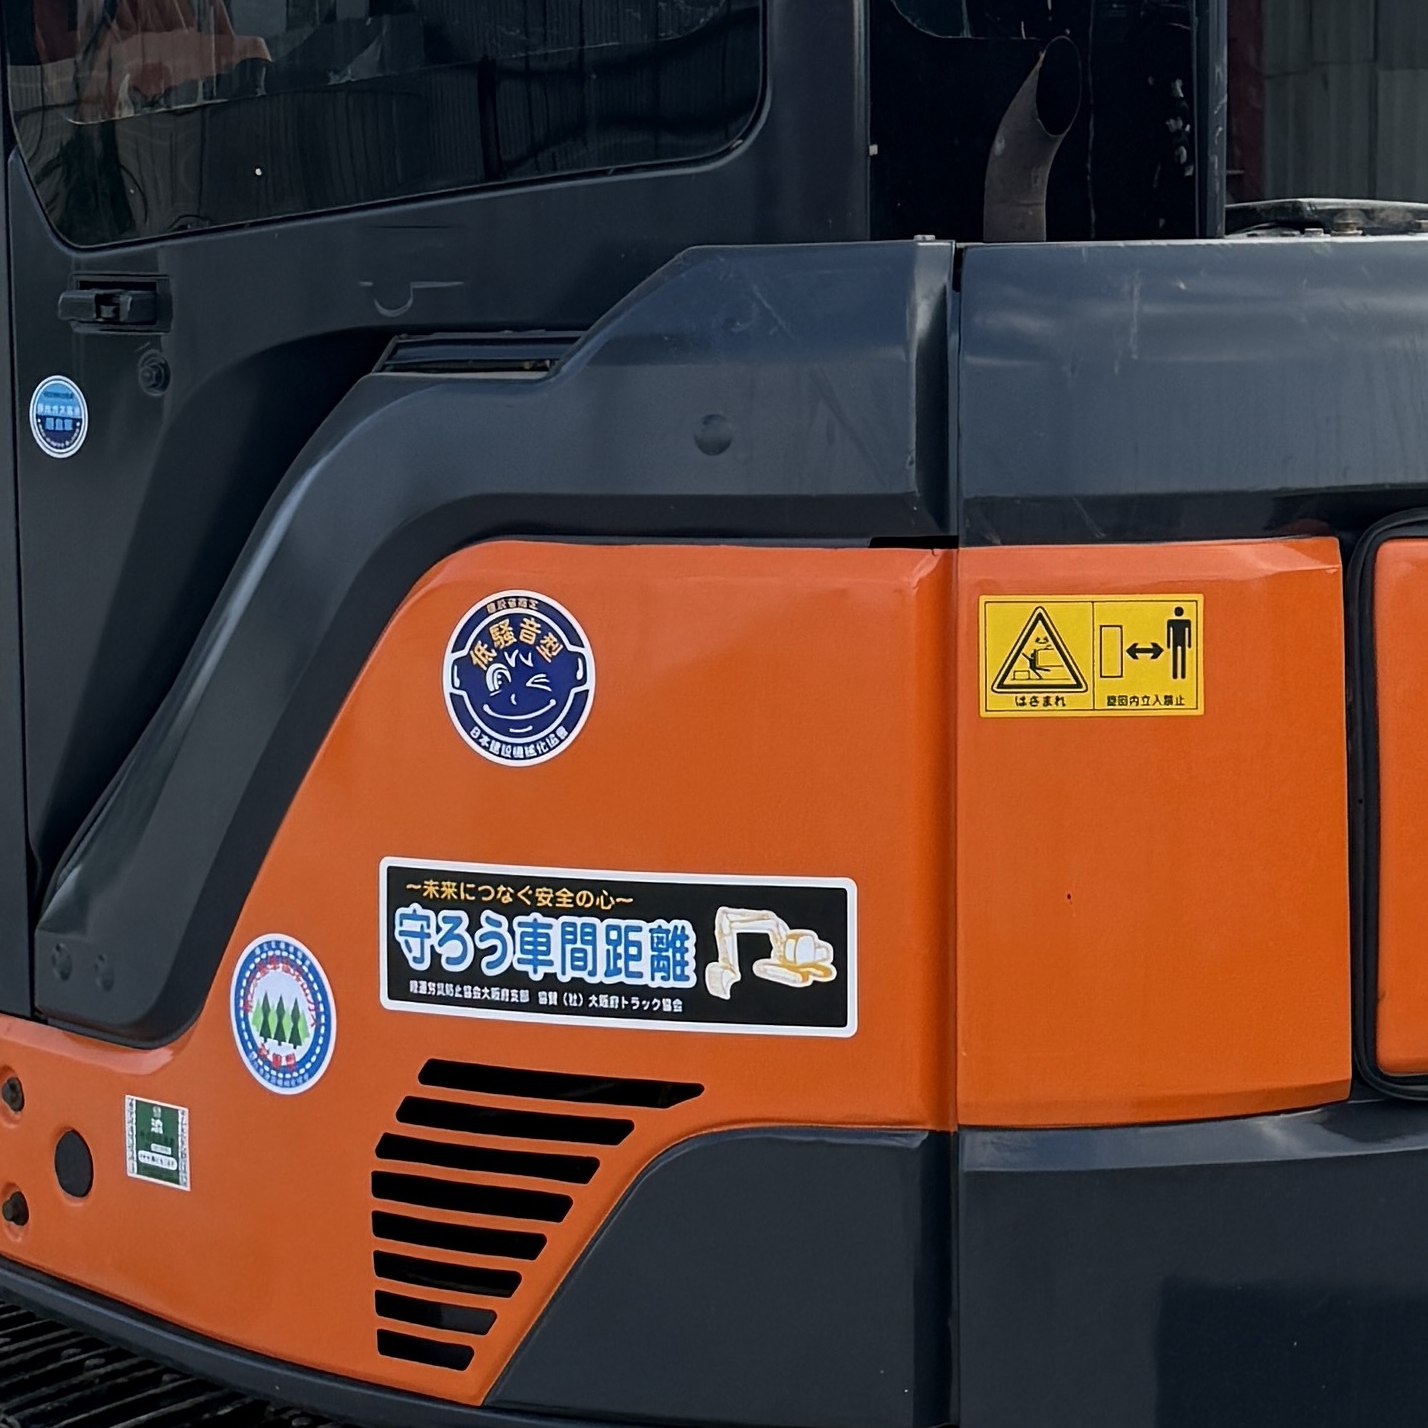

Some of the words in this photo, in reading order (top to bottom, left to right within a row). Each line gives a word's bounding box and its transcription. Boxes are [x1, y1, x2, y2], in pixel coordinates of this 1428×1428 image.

[469, 616, 564, 671] 低騒音型
[1014, 694, 1067, 708] はさまれ
[394, 902, 697, 989] 守ろう車間距離
